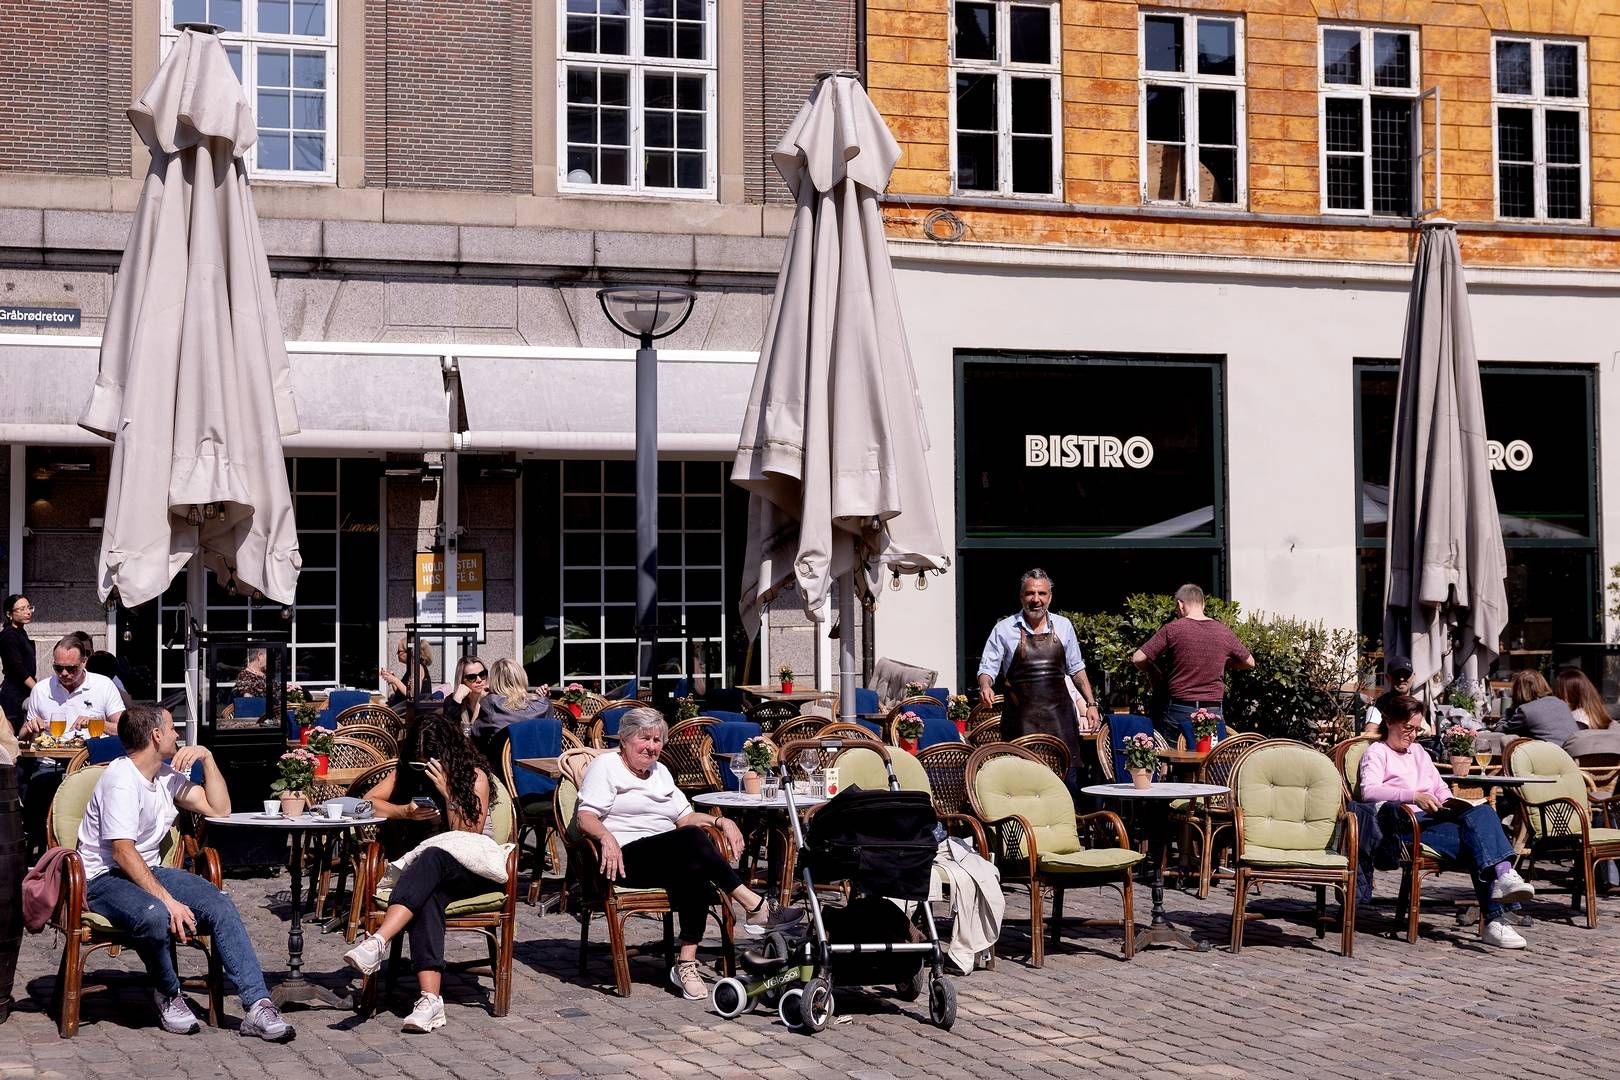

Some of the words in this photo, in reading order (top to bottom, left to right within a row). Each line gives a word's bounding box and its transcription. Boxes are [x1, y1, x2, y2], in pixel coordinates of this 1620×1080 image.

[0, 309, 75, 322] Gråbrødretorv
[1025, 434, 1154, 469] BISTRO
[456, 558, 477, 570] STEN
